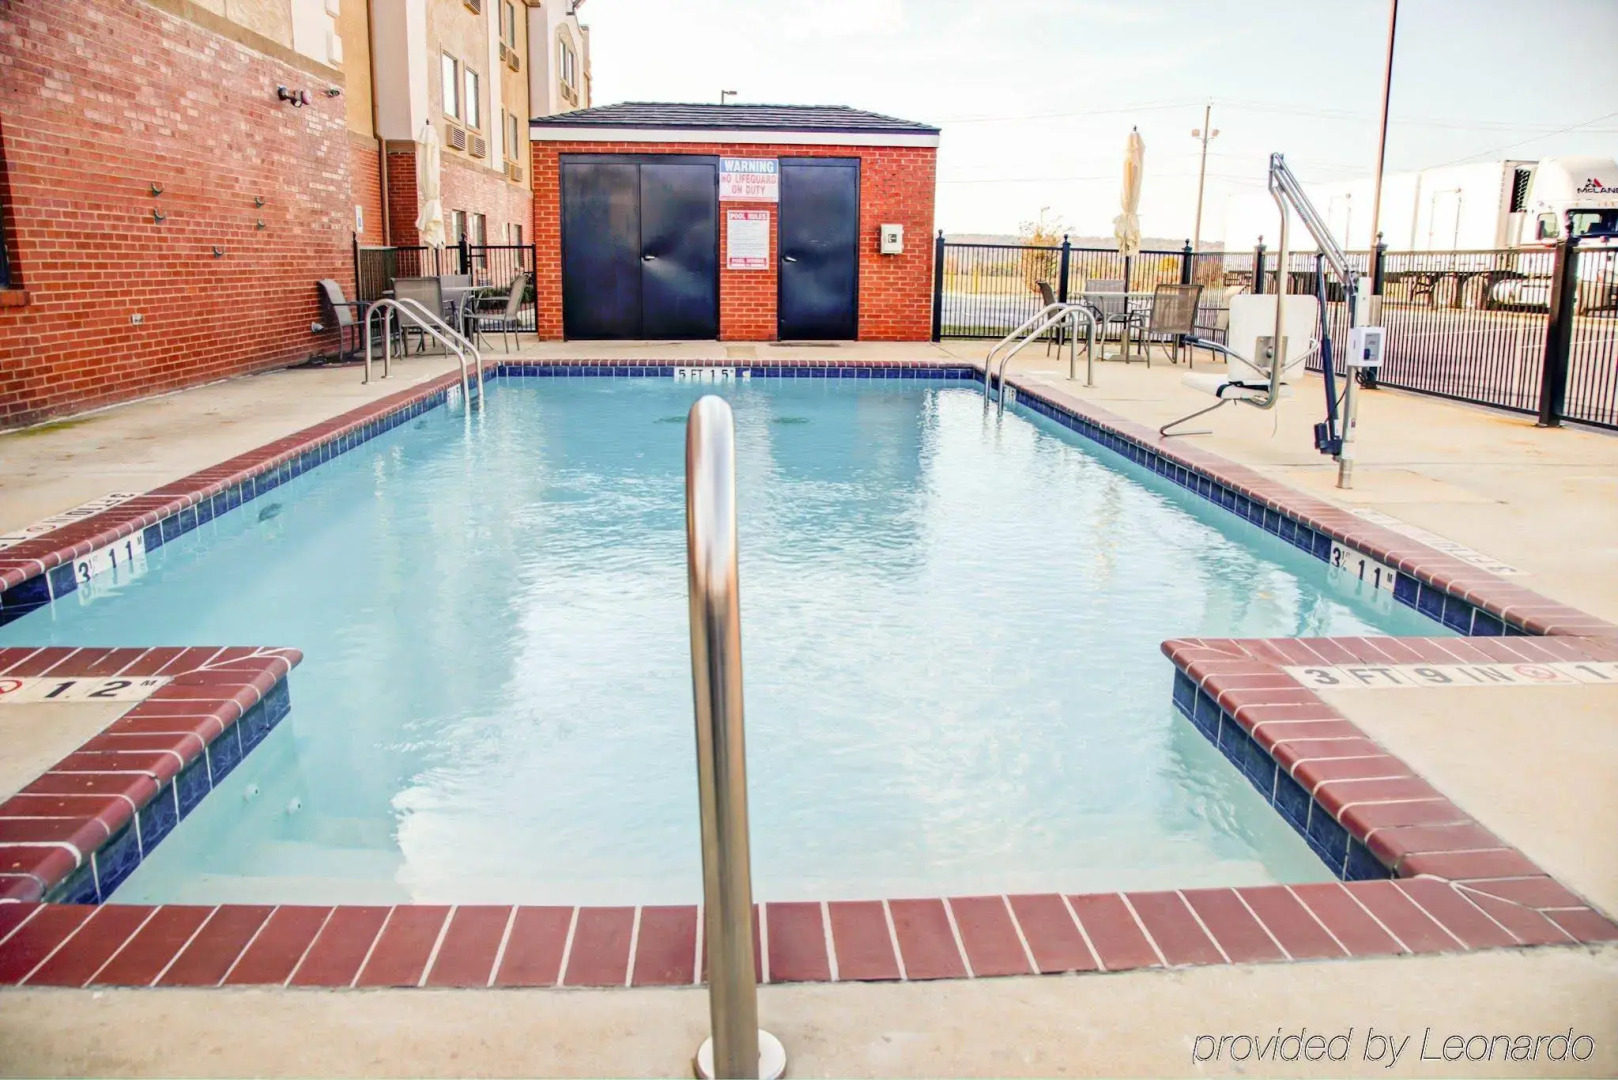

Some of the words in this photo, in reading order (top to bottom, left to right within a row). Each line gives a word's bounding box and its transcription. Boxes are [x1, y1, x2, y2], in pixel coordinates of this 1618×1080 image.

[724, 159, 775, 173] WARNING
[721, 174, 732, 183] NO
[735, 174, 776, 185] LIFEGUARD
[731, 185, 742, 194] ON
[746, 185, 766, 195] DUTY
[1304, 668, 1340, 685] 3
[1349, 668, 1404, 685] FT
[1414, 667, 1454, 684] 9
[1456, 666, 1516, 683] IN
